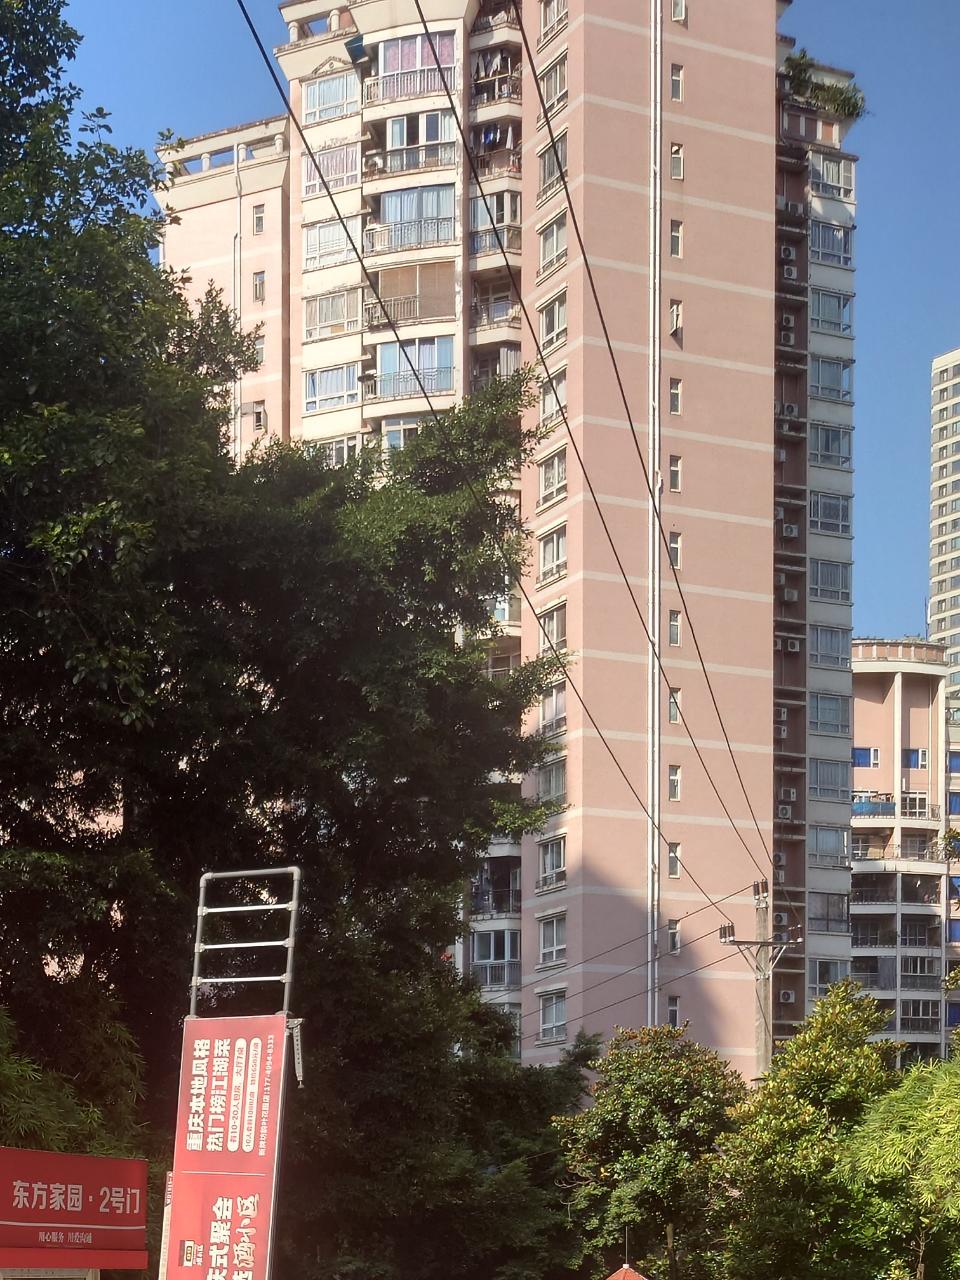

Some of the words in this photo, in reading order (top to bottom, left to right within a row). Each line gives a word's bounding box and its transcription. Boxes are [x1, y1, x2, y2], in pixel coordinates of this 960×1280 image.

[186, 1039, 211, 1151] 重庆本地风格
[206, 1039, 231, 1152] 热门榜江湖菜
[38, 1232, 64, 1243] 用心服务
